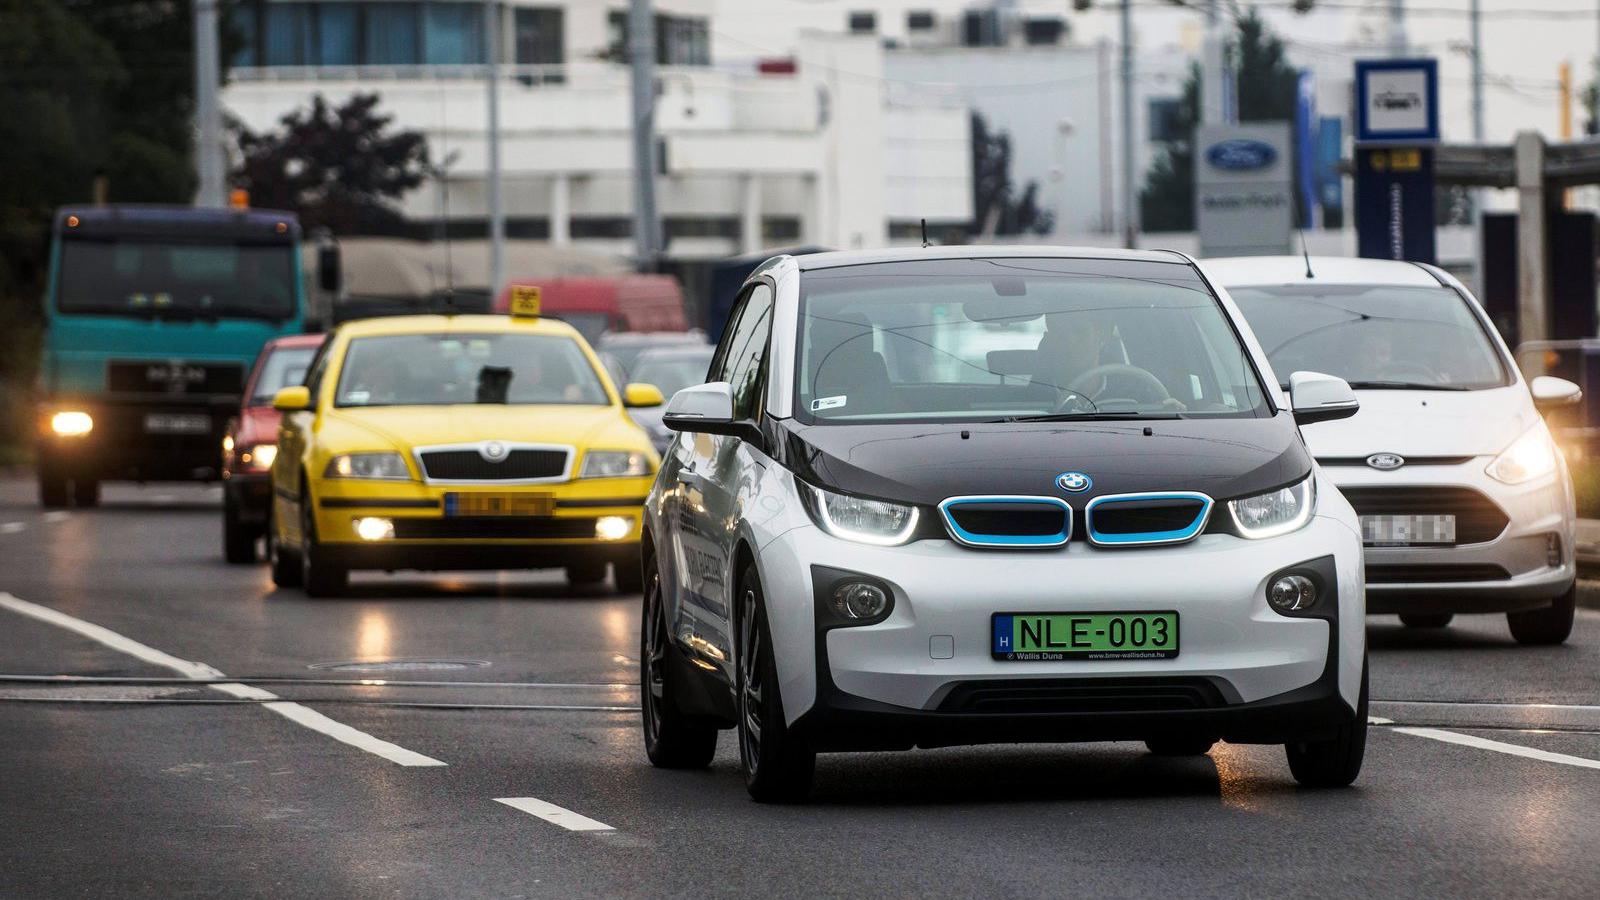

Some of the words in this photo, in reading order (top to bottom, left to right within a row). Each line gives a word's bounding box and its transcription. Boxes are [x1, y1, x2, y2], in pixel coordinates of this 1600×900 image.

[1020, 617, 1168, 648] NLE-003
[1000, 636, 1009, 647] H
[1017, 652, 1040, 660] Wallis
[1042, 652, 1063, 660] Duna
